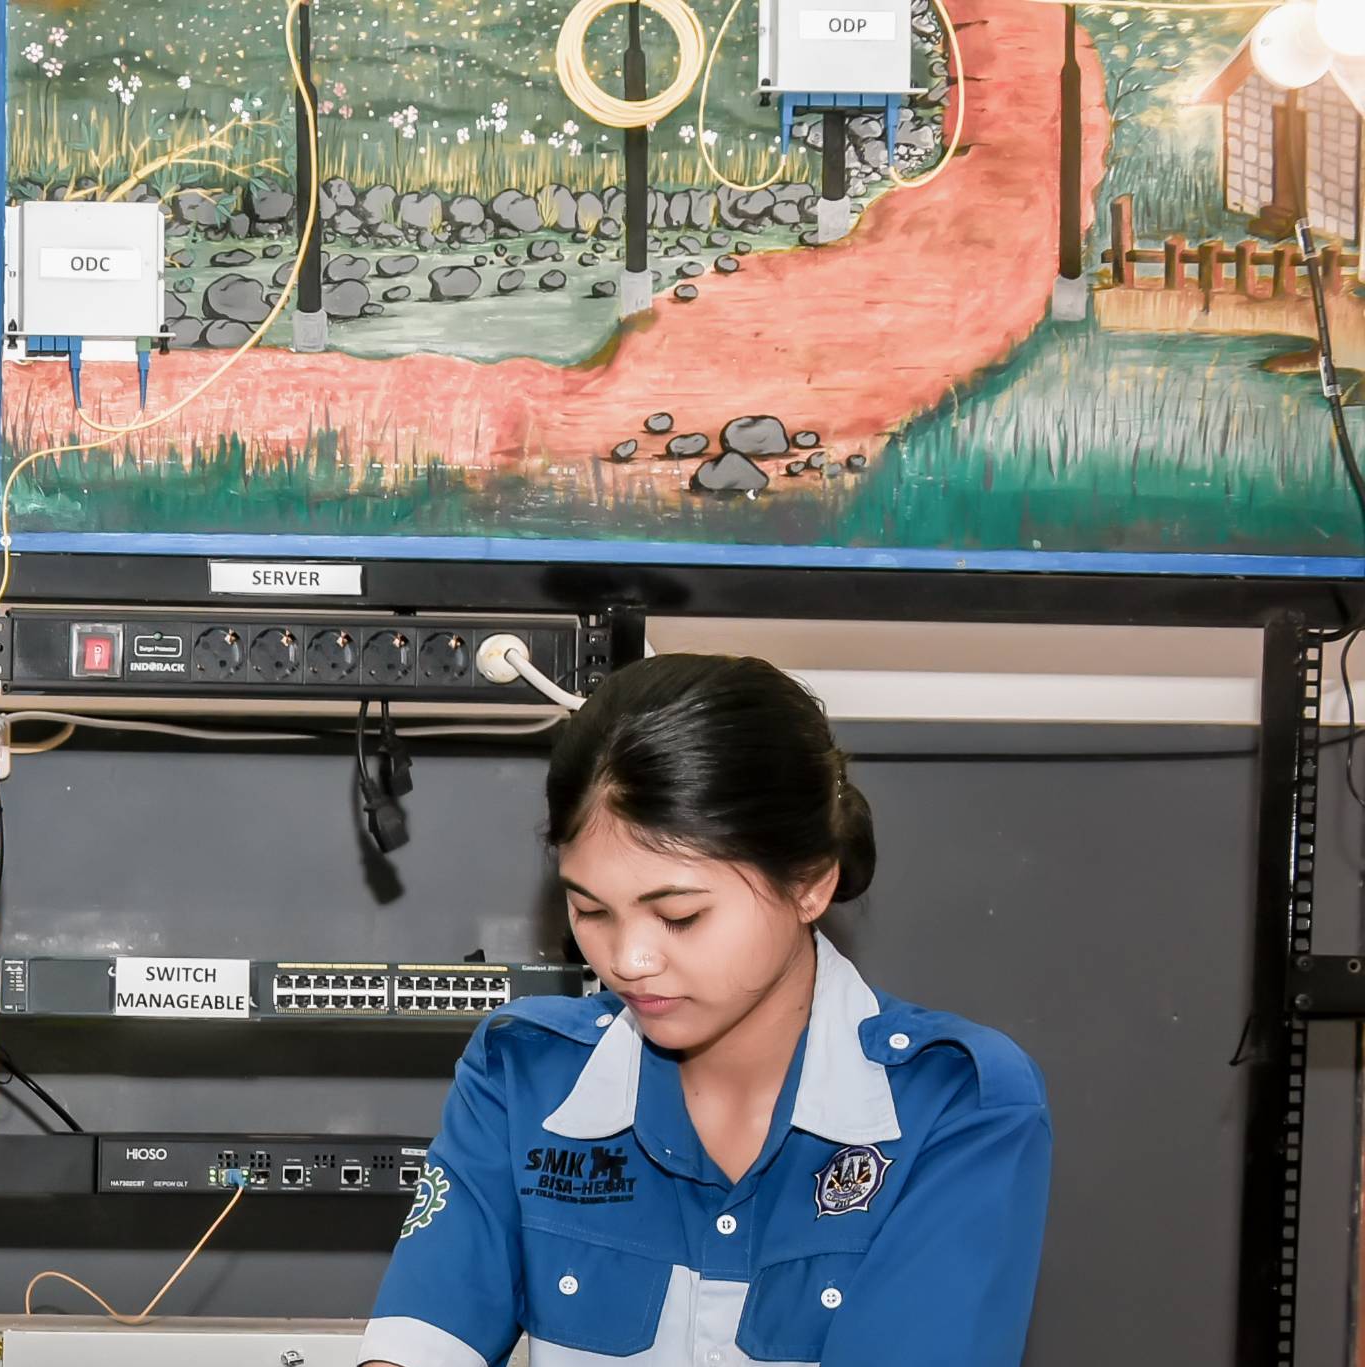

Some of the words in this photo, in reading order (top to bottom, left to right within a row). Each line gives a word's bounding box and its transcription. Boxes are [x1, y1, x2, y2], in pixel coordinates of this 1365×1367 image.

[828, 17, 868, 34] ODP
[70, 255, 111, 273] ODC
[251, 568, 320, 587] SERVER
[145, 966, 217, 983] SWITCH
[521, 964, 546, 972] Catalyst
[117, 992, 245, 1011] MANAGEABLE
[524, 1147, 586, 1178] SMK
[538, 1174, 637, 1196] BISA-HEBAT
